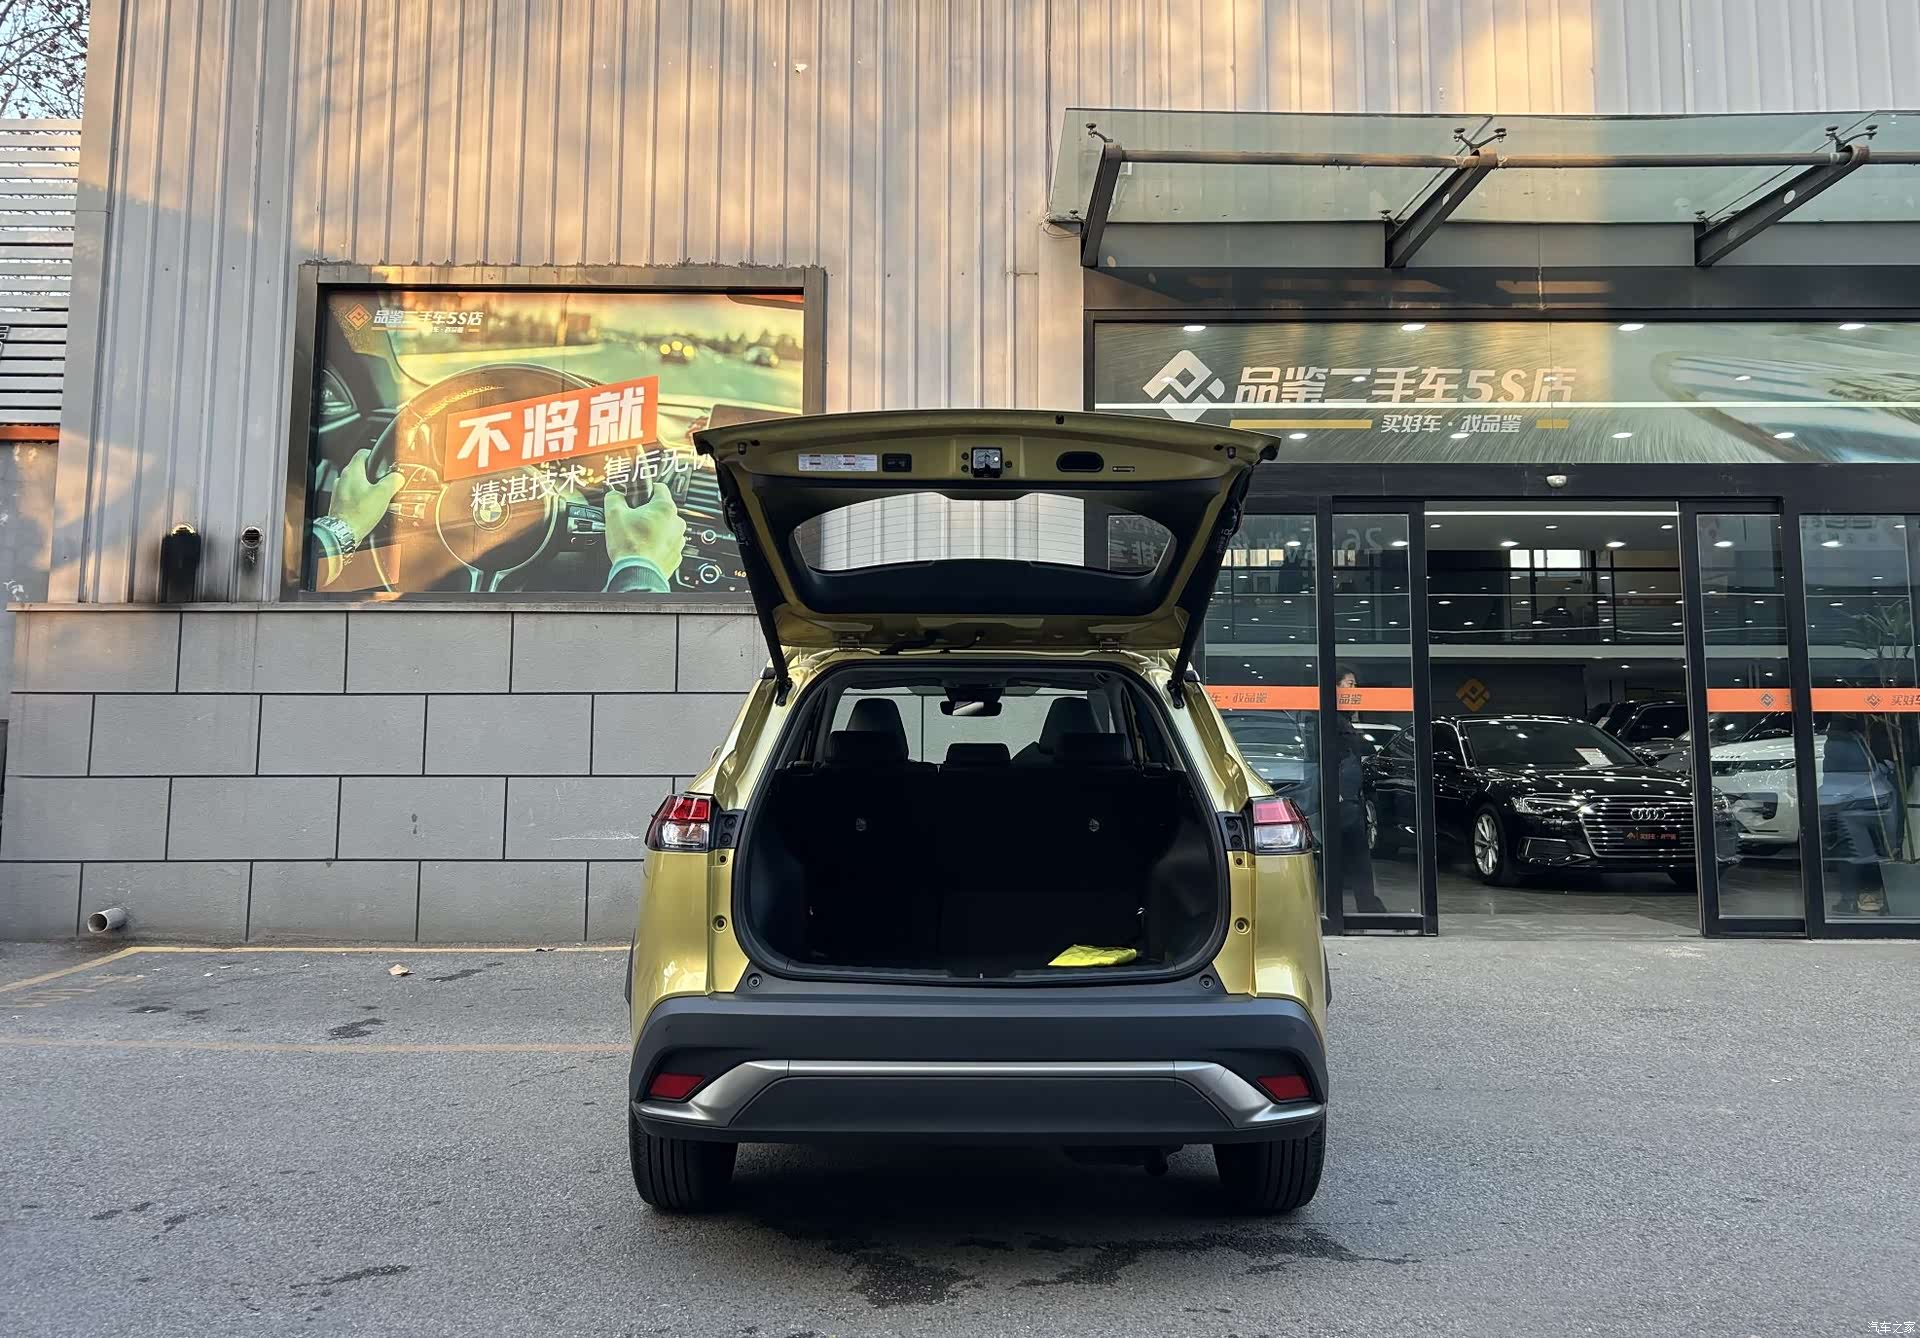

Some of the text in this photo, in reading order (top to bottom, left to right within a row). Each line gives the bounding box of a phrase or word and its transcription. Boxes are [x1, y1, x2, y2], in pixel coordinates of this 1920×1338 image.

[1234, 366, 1577, 404] 品鉴二手车5S店
[457, 386, 645, 469] 不将就
[1381, 414, 1523, 434] 买好车·找品鉴
[470, 464, 588, 509] 精湛技术
